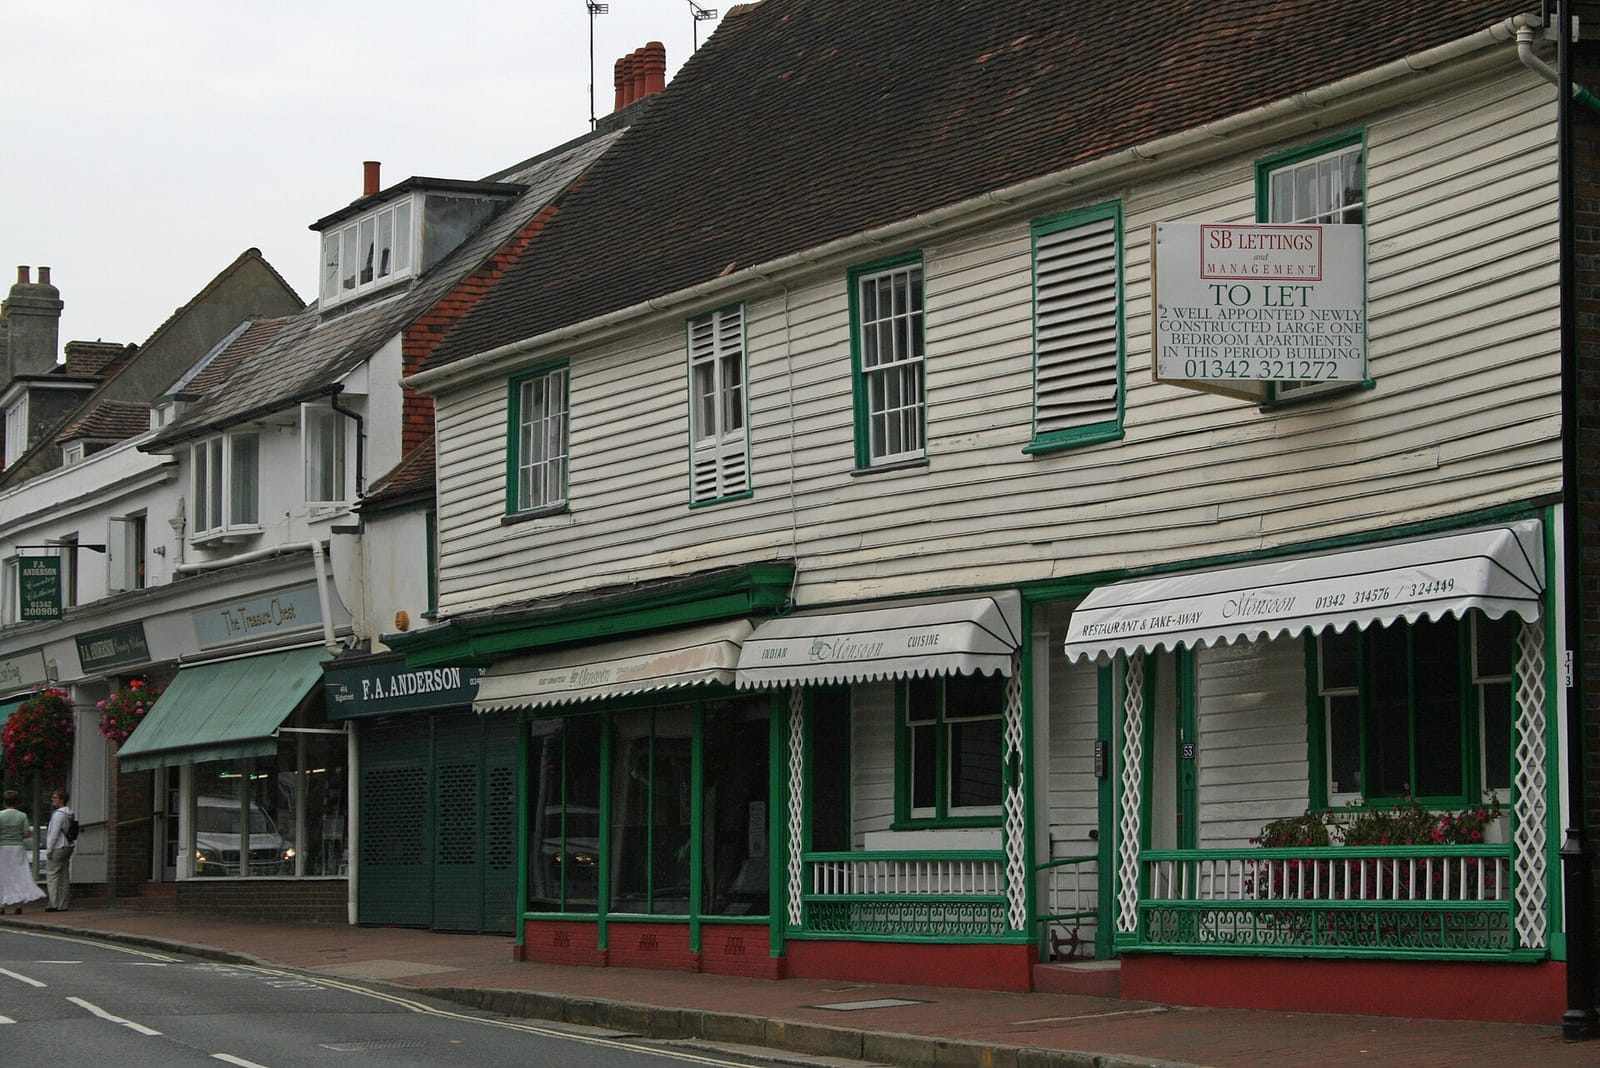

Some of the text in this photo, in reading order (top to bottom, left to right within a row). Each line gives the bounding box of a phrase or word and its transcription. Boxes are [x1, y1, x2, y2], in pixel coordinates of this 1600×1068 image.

[1210, 230, 1313, 250] SB LETTINGS
[1253, 253, 1269, 261] and
[1207, 263, 1316, 275] MANAGEMENT
[1209, 284, 1314, 307] TO LET
[1160, 307, 1363, 321] 2 WELL APPOINTED NEWLY
[1159, 320, 1363, 334] CONSTRUCTED LARGE ONE
[1171, 333, 1352, 347] BEDROOM APARTMENTS
[1162, 346, 1360, 360] IN THIS PERIOD BUILDING
[1184, 360, 1338, 379] 01342 321272
[23, 568, 57, 576] ANDERSON
[24, 607, 58, 616] 300906
[1082, 619, 1138, 637] RESTAURANT
[1139, 619, 1147, 631] &
[1149, 612, 1203, 629] TAKE-AWAY
[1222, 592, 1296, 618] Monsoon
[1315, 593, 1346, 609] 01342
[1352, 587, 1390, 604] 314576
[1409, 578, 1455, 597] 324449
[221, 598, 296, 636] The Treasure Chest
[761, 634, 940, 660] INDIAN Monsoon CUISINE
[1183, 745, 1193, 757] 53
